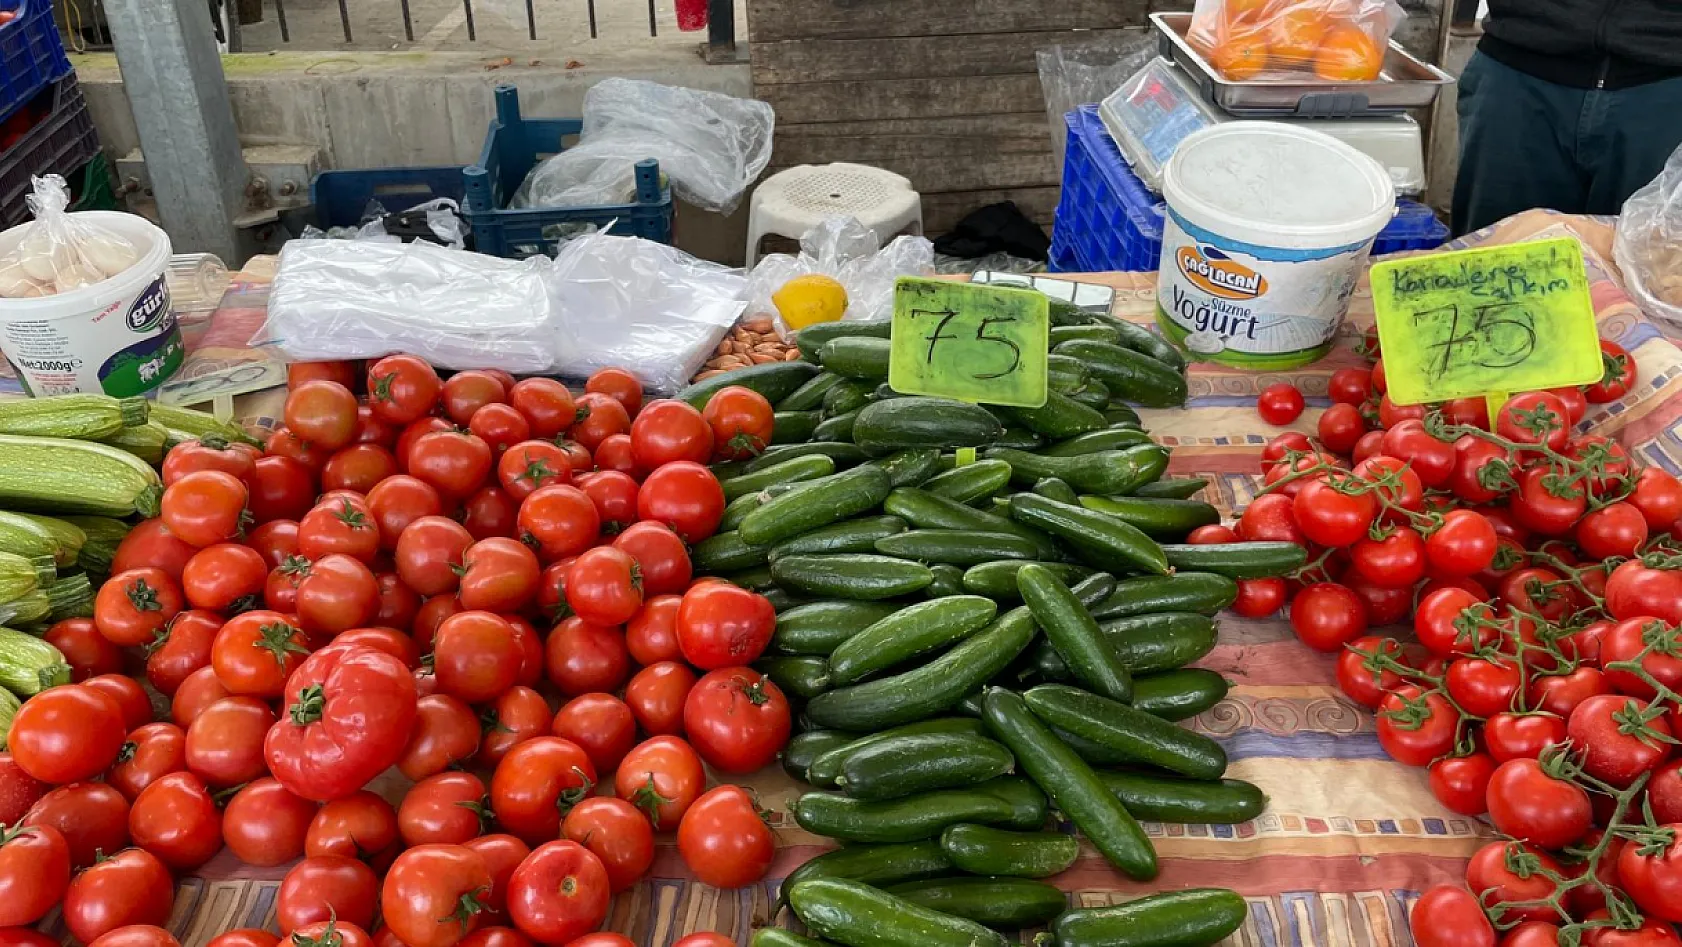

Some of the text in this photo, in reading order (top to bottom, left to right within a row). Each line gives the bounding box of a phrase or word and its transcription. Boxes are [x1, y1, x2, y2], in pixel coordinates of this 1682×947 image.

[1184, 253, 1261, 294] ÇAĞLACAN
[1173, 284, 1260, 340] Yoğurt
[1211, 297, 1252, 317] Süzme
[909, 308, 1021, 380] 75
[1413, 302, 1537, 380] 75
